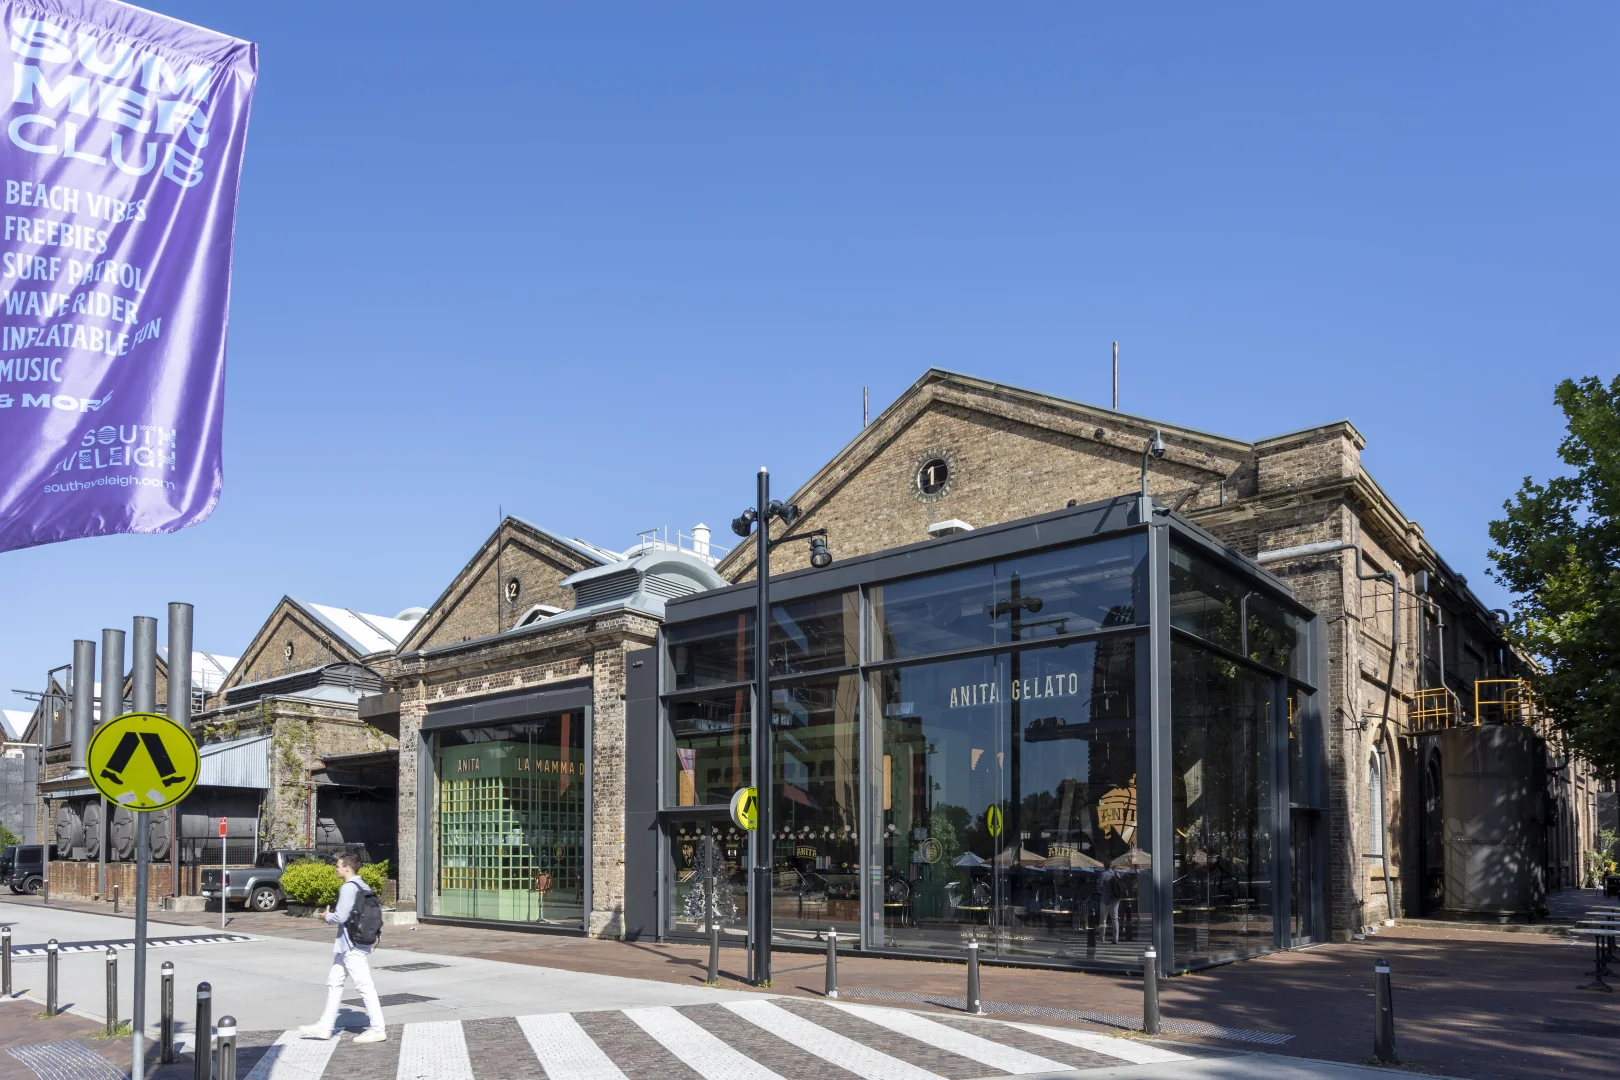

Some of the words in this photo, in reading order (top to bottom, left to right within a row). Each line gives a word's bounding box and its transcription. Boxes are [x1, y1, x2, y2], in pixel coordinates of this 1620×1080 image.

[11, 17, 213, 104] SUM
[12, 61, 210, 150] MER
[7, 114, 204, 188] CLUB
[5, 180, 79, 214] BEACH
[86, 192, 147, 223] VIBES
[5, 215, 108, 254] FREEBIES
[3, 252, 61, 281] SURF
[68, 259, 145, 294] PATROL
[3, 323, 129, 356] INFLATABLE
[131, 317, 162, 350] FUN
[0, 357, 63, 383] MUSIC
[82, 424, 176, 449] SOUTH
[44, 475, 175, 493] southeveleigh.com
[927, 465, 935, 486] 1
[510, 583, 517, 597] 2
[949, 682, 1000, 708] ANITA
[1011, 672, 1078, 701] GELATO
[457, 758, 480, 773] ANITA
[517, 757, 530, 771] LA
[536, 759, 575, 775] MAMMA
